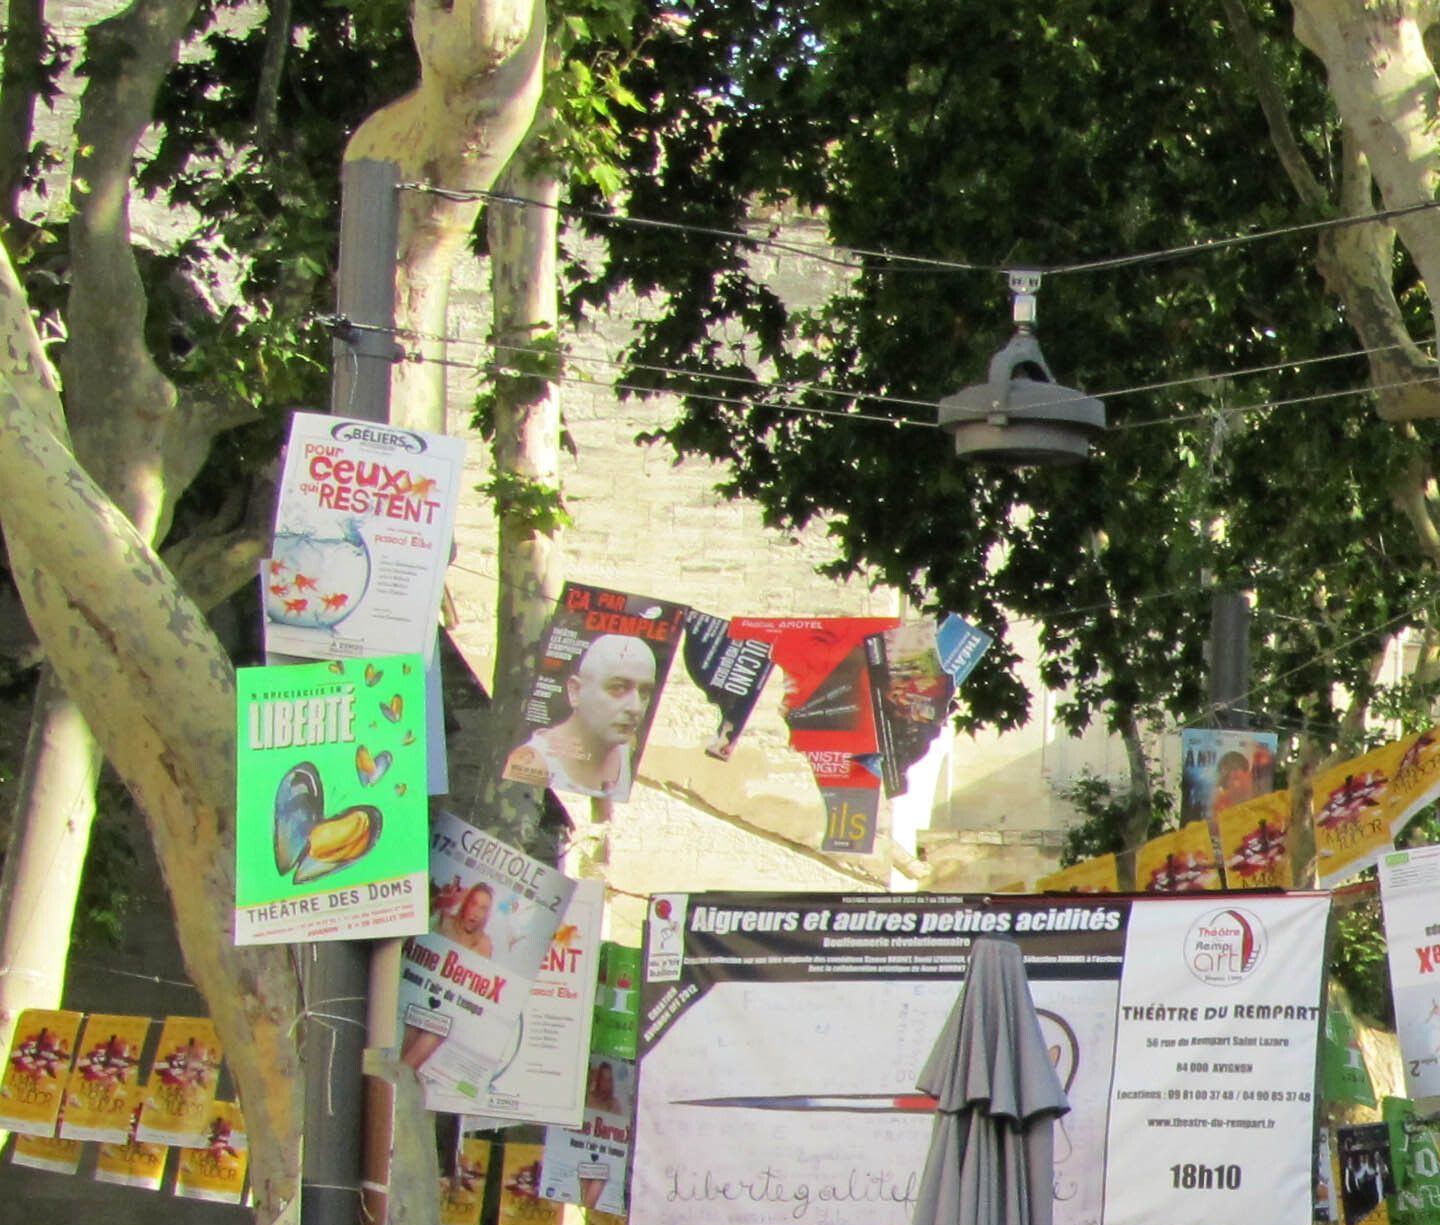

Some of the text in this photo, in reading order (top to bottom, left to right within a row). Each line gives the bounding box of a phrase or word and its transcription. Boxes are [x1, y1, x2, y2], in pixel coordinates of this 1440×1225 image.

[305, 443, 344, 458] pour
[309, 456, 407, 494] ceux
[300, 482, 440, 524] qui RESTENT
[586, 612, 669, 641] EXEMPLE
[724, 639, 773, 697] ULCANO
[251, 686, 357, 751] LIBERTÉ
[461, 830, 547, 891] CAPITOLE
[247, 878, 414, 925] THÉÂTRE DES DOMS
[691, 906, 1121, 935] Aigreurs et autres petites acidités
[1199, 926, 1241, 938] Théâtre
[402, 936, 441, 973] Anne
[440, 949, 507, 1004] BerneX
[1194, 946, 1242, 974] art
[1122, 1003, 1320, 1022] THÉÂTRE DU REMPART
[1160, 1038, 1177, 1048] rue
[1191, 1036, 1231, 1049] Rempart
[1233, 1036, 1258, 1048] Saint
[1212, 1063, 1253, 1074] AVIGNON
[1117, 1089, 1163, 1101] Locations
[1170, 1163, 1241, 1190] 18h10
